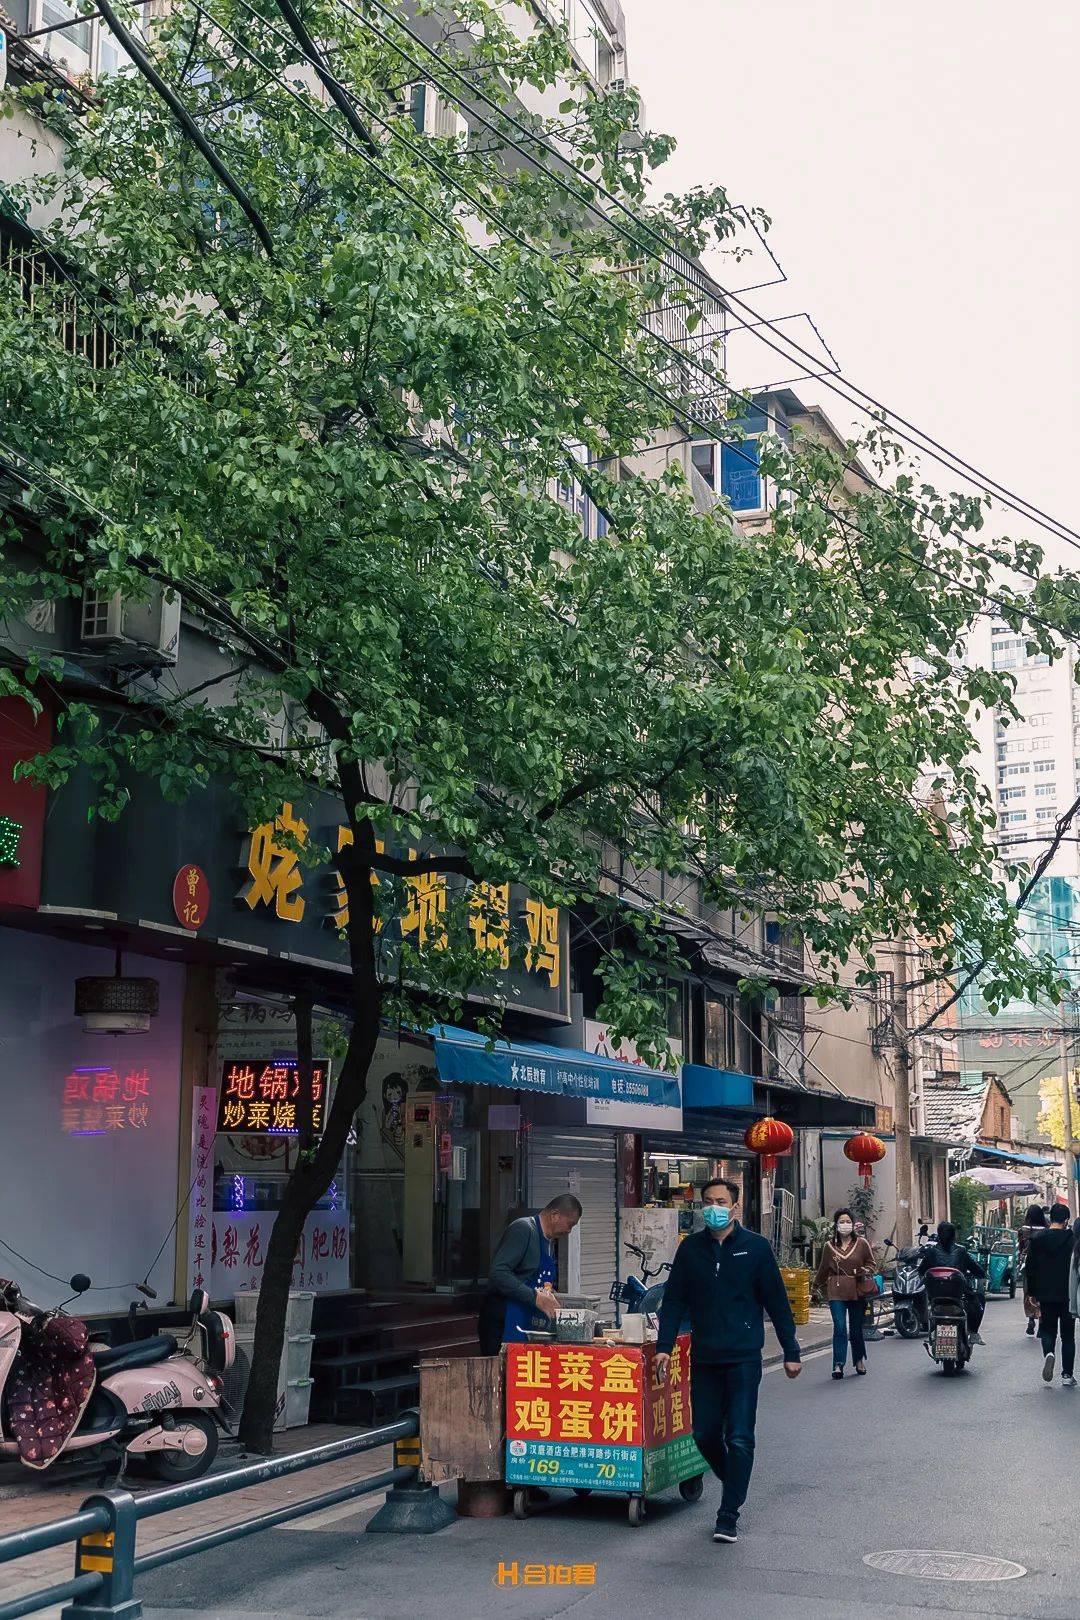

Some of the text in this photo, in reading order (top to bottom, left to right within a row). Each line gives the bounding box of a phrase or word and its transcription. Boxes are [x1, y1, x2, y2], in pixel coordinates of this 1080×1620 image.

[183, 868, 200, 924] 曾记
[519, 1064, 546, 1085] 北辰教育
[515, 1350, 639, 1393] 韭菜盒
[514, 1396, 639, 1442] 鸡蛋饼
[652, 1391, 692, 1438] 鸡蛋
[528, 1459, 560, 1475] 169
[529, 1444, 638, 1462] 汉庭酒店合肥淮河路步行街店
[596, 1463, 617, 1479] 70
